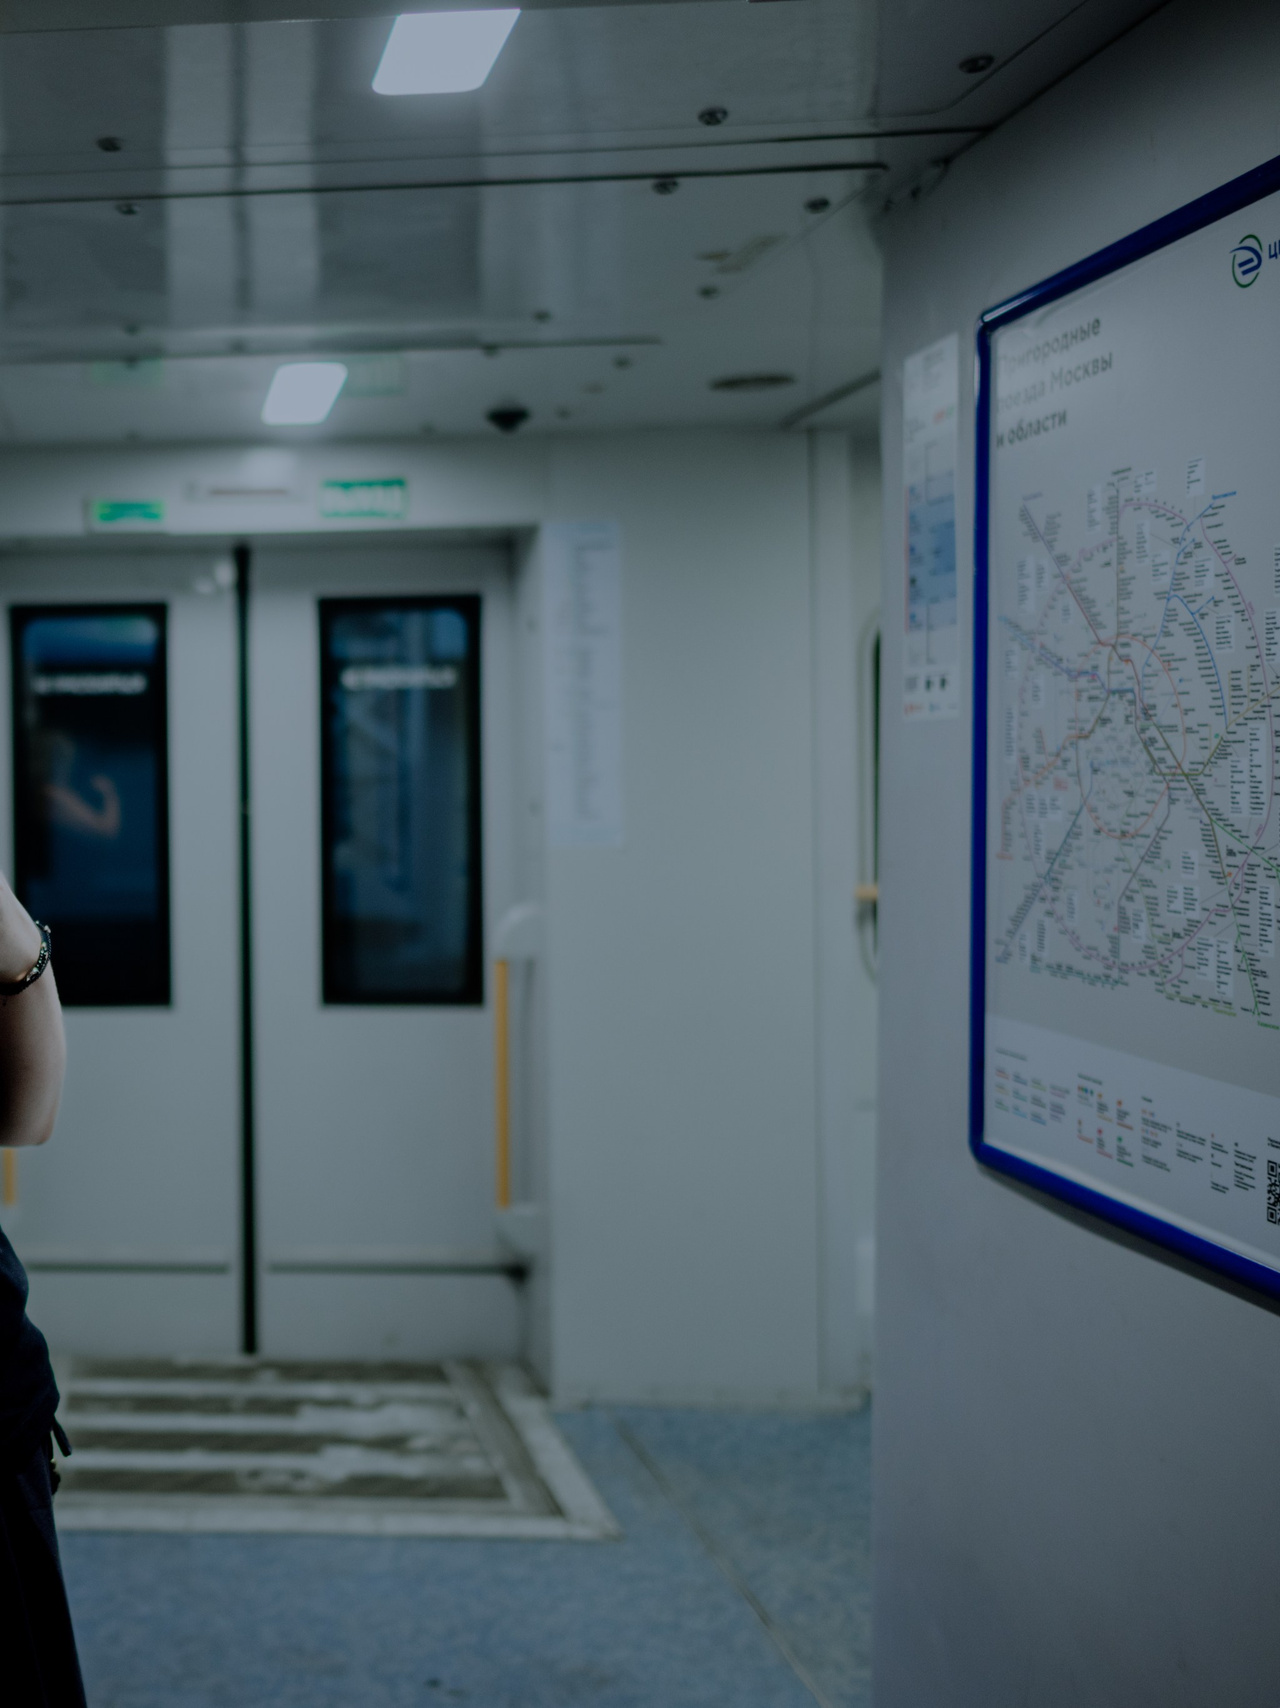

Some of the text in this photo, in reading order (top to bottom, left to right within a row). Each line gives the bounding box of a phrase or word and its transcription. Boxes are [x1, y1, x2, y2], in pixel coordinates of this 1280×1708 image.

[1269, 239, 1280, 260] Ц
[1050, 351, 1113, 393] Москвы
[996, 409, 1067, 448] и области
